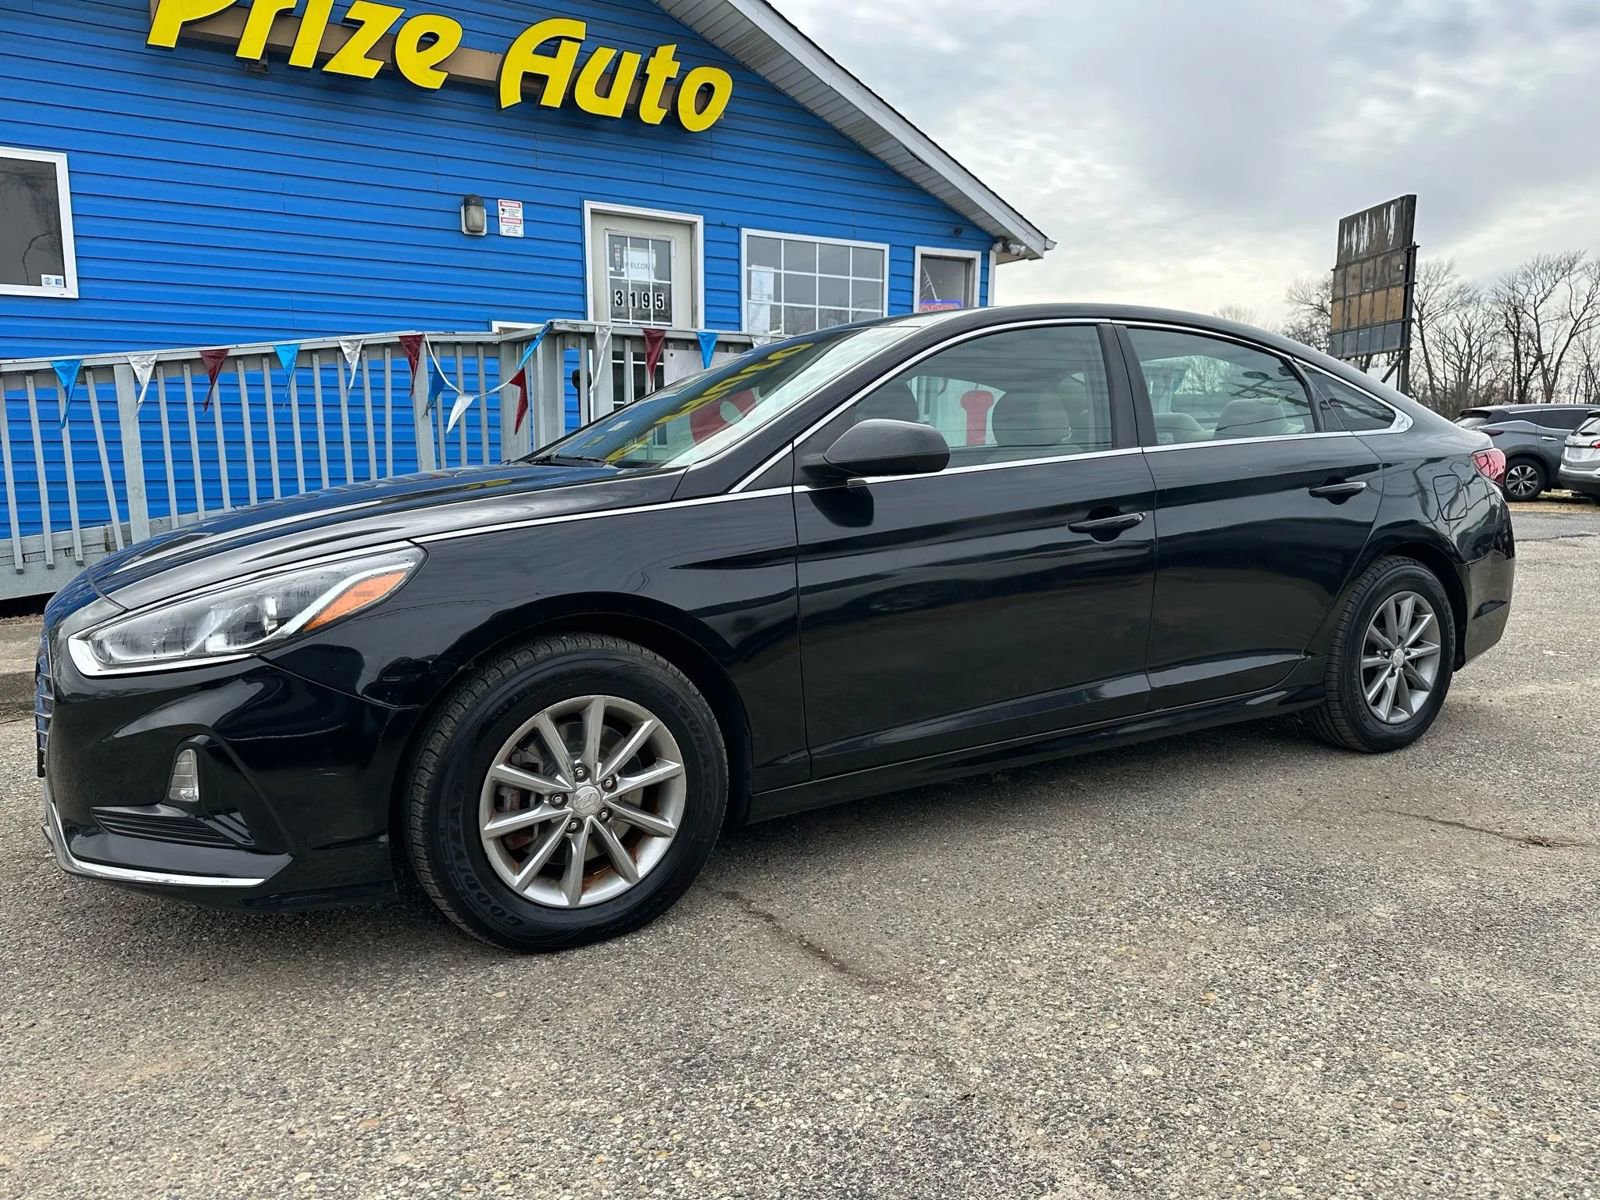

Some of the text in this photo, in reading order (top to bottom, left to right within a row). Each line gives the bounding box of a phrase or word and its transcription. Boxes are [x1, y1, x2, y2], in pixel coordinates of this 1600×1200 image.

[146, 0, 733, 133] Prize Auto
[615, 290, 663, 309] 3195
